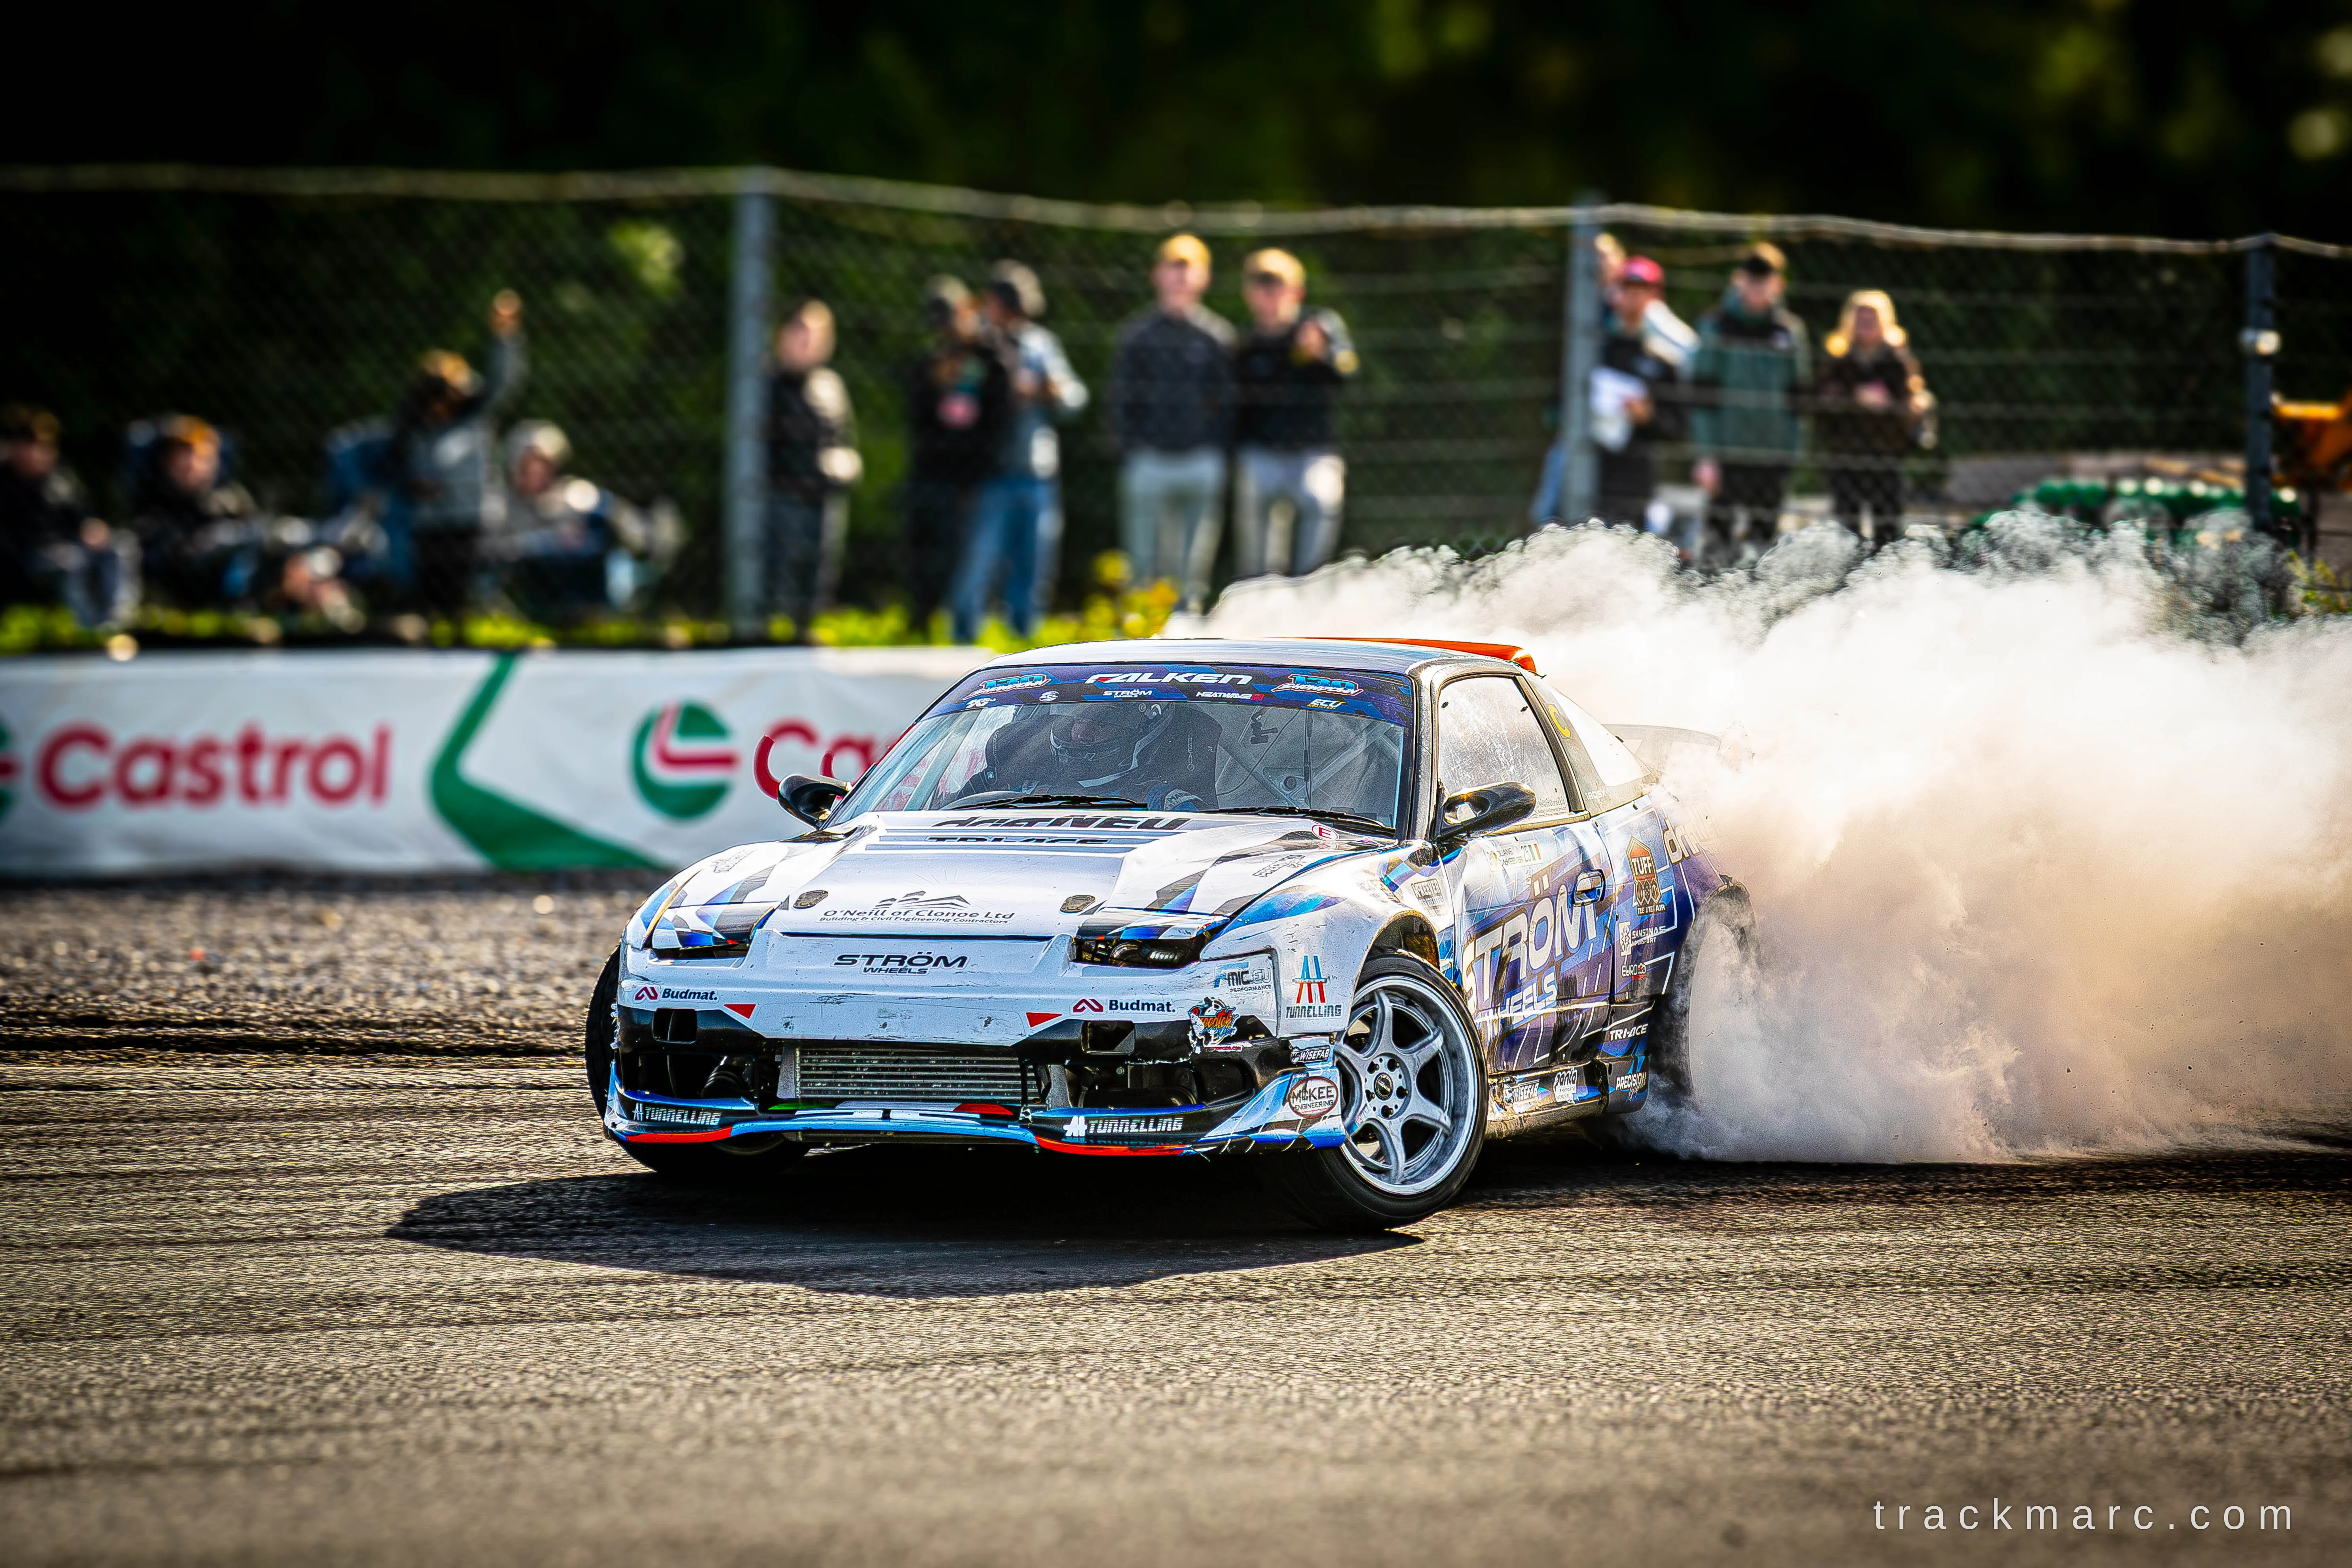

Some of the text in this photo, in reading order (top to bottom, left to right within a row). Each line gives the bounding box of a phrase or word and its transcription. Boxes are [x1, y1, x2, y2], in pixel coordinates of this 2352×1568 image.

[1084, 673, 1253, 685] FALKEN
[1293, 675, 1355, 690] 130
[1280, 683, 1359, 694] SHOWDOWN
[1310, 699, 1344, 707] ECU
[35, 722, 391, 811] Castrol
[1318, 827, 1332, 839] E
[1631, 856, 1652, 875] TUFF
[1632, 925, 1666, 940] SAMSONAS
[1463, 874, 1597, 1013] STRÖM
[833, 951, 968, 968] STRÖM
[1229, 984, 1272, 993] PERFORMANCE
[1286, 1004, 1342, 1018] TUNNELLING
[1610, 1023, 1648, 1041] TRI-ACE
[1300, 1049, 1330, 1061] WISEFAB
[1616, 1072, 1647, 1091] PRECISION
[1295, 1100, 1334, 1111] ENGINEERING
[645, 1107, 721, 1126] TUNNELLING
[1088, 1117, 1184, 1133] TUNNELLING
